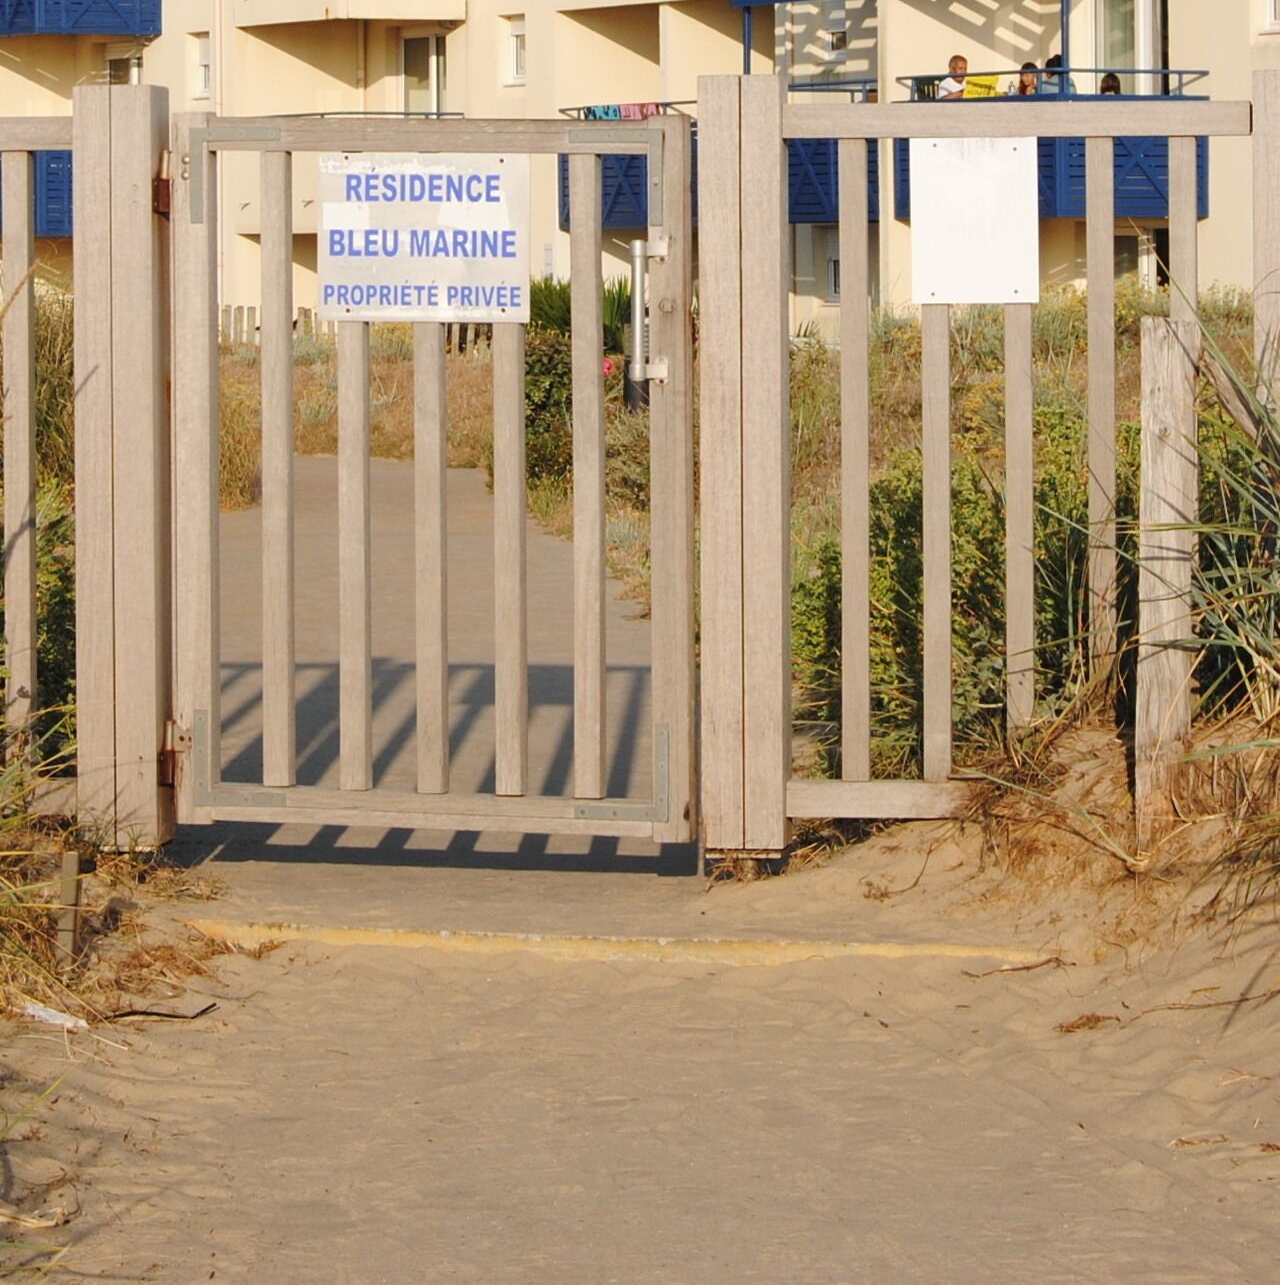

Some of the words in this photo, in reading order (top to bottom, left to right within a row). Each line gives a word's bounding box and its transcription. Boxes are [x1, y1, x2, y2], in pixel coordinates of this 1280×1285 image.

[345, 167, 501, 203] RÉSIDENCE
[328, 229, 400, 257] BLEU
[409, 229, 517, 259] MARINE
[323, 279, 439, 307] PROPRIÉTÉ
[446, 280, 522, 308] PRIVÉE
